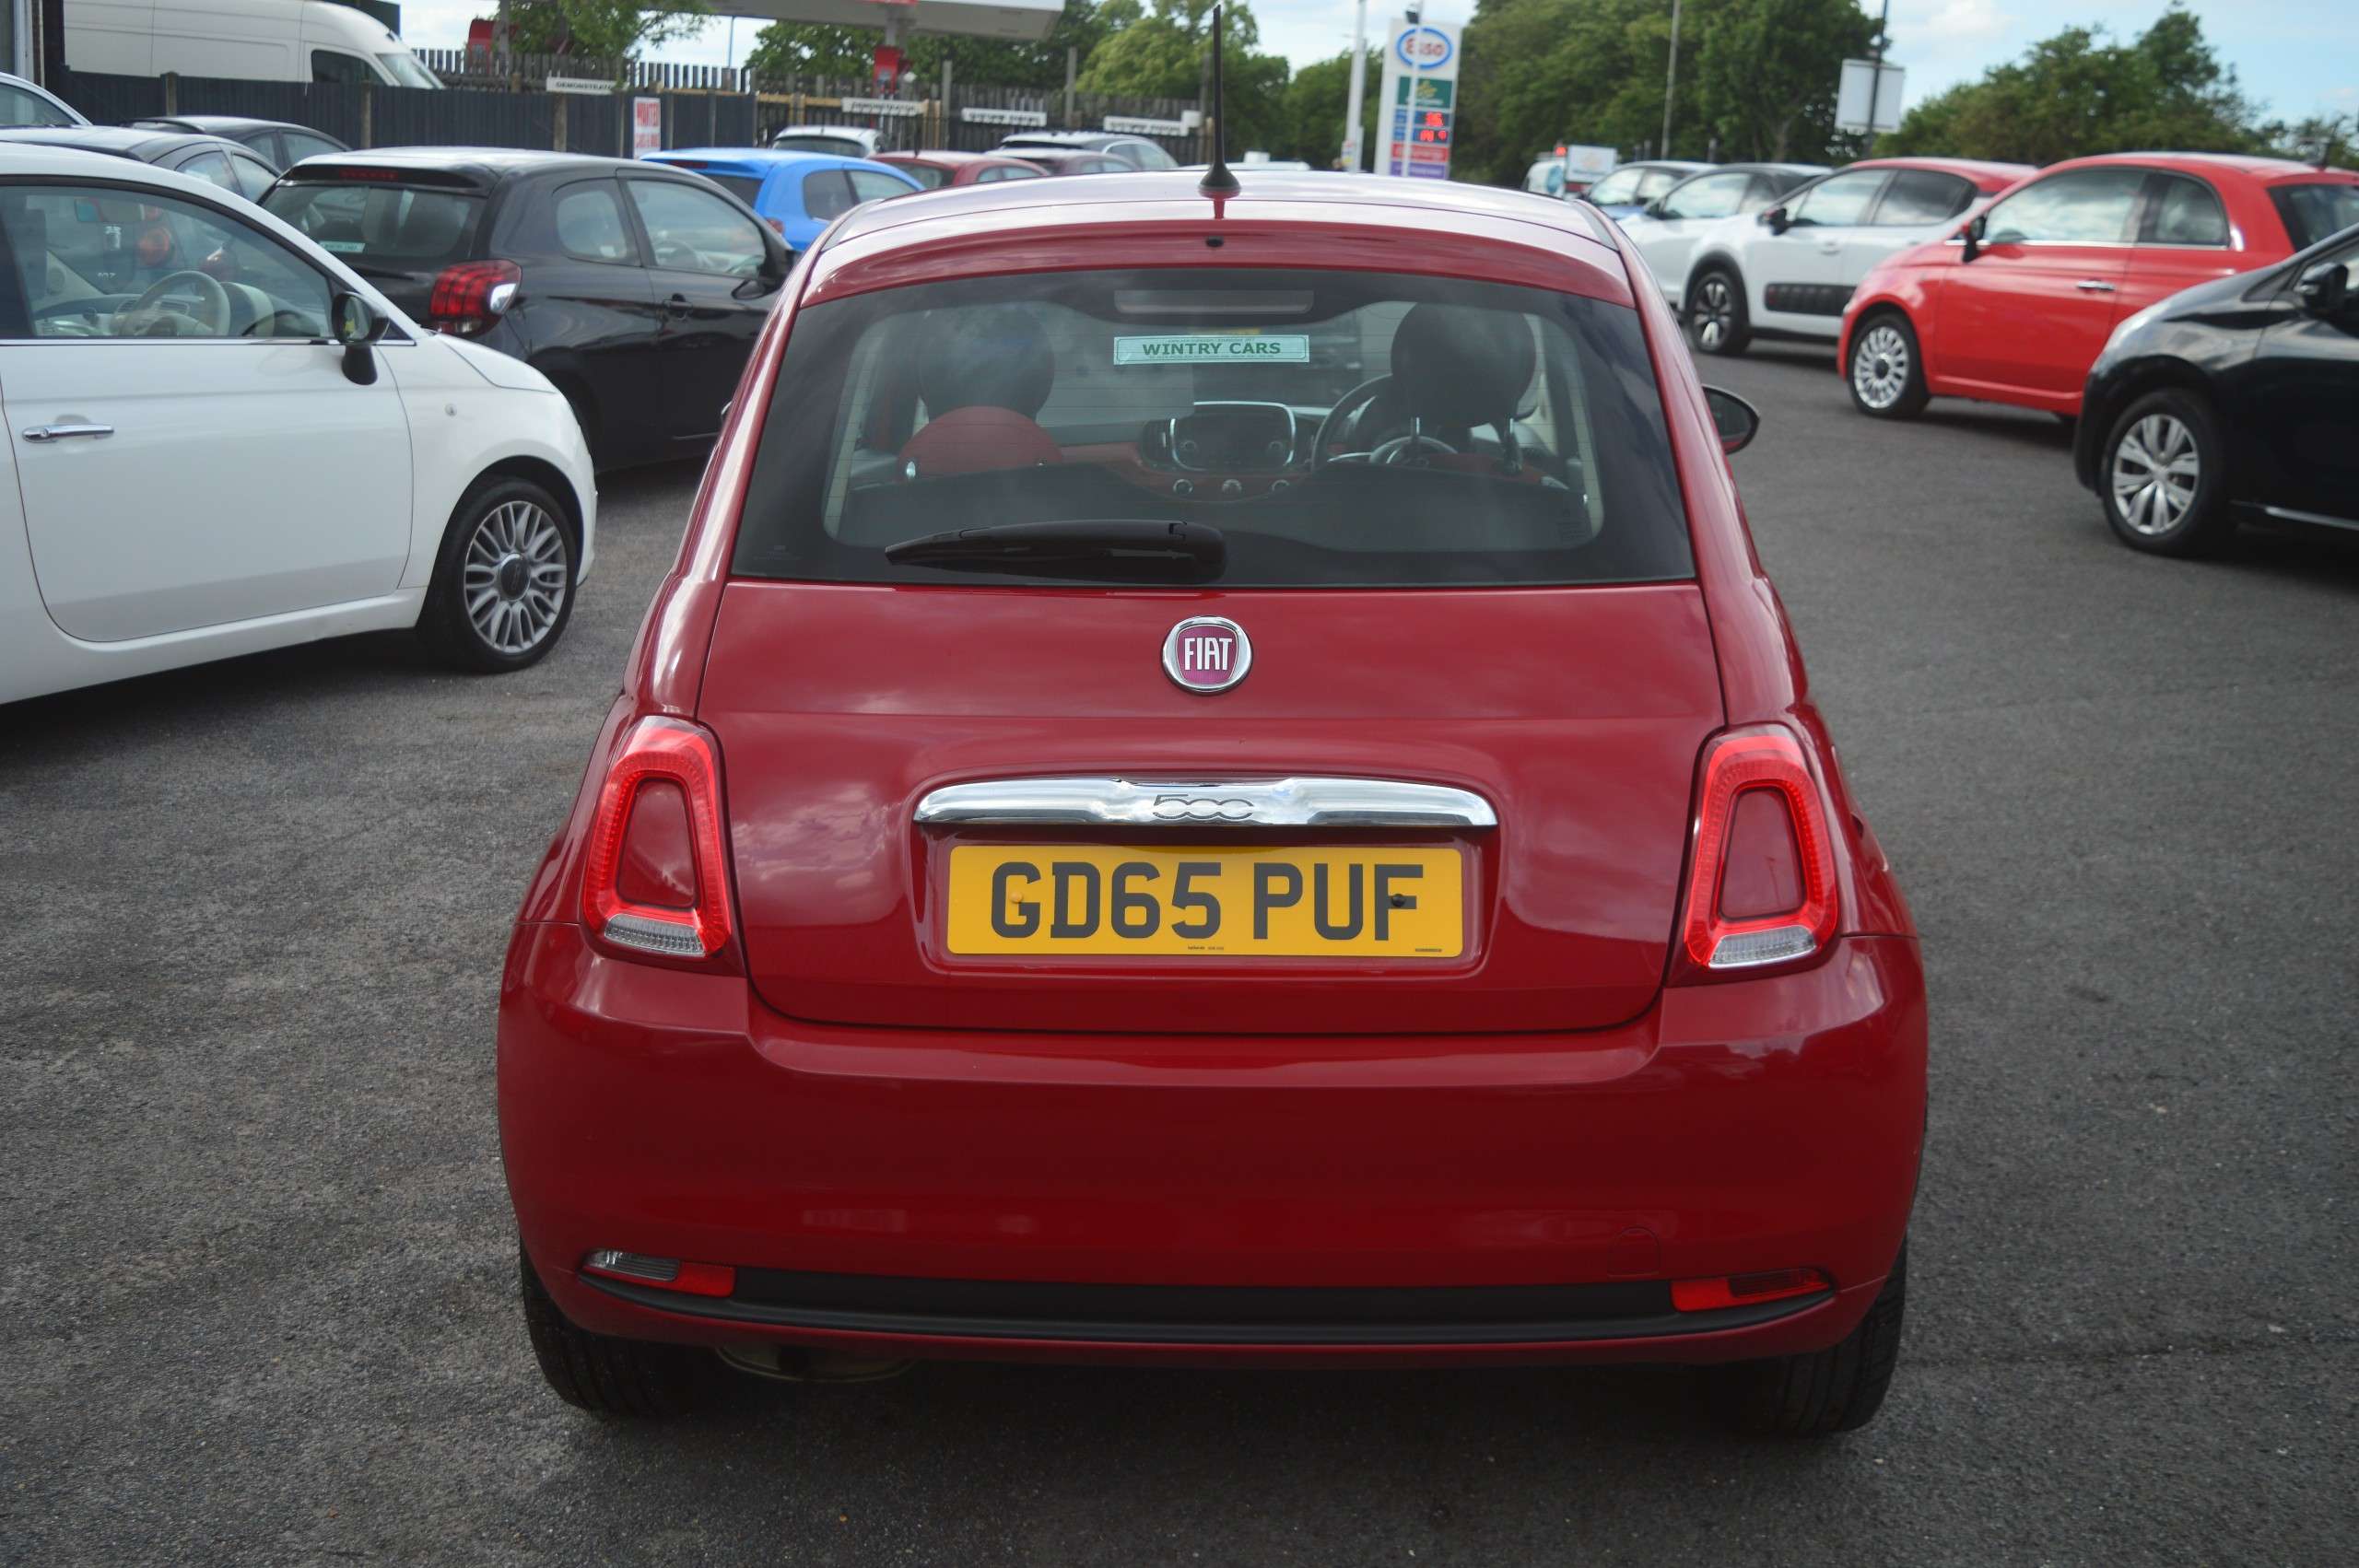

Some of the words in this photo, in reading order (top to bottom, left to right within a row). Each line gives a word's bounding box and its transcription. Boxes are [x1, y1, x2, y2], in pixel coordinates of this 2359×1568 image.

[556, 81, 613, 89] DEMONSTRATO
[1143, 343, 1222, 356] WINTRY
[1229, 342, 1281, 355] CARS
[1184, 638, 1232, 671] FIAT
[1152, 793, 1254, 820] 500
[991, 861, 1222, 940] GD65
[1252, 862, 1425, 942] PUF
